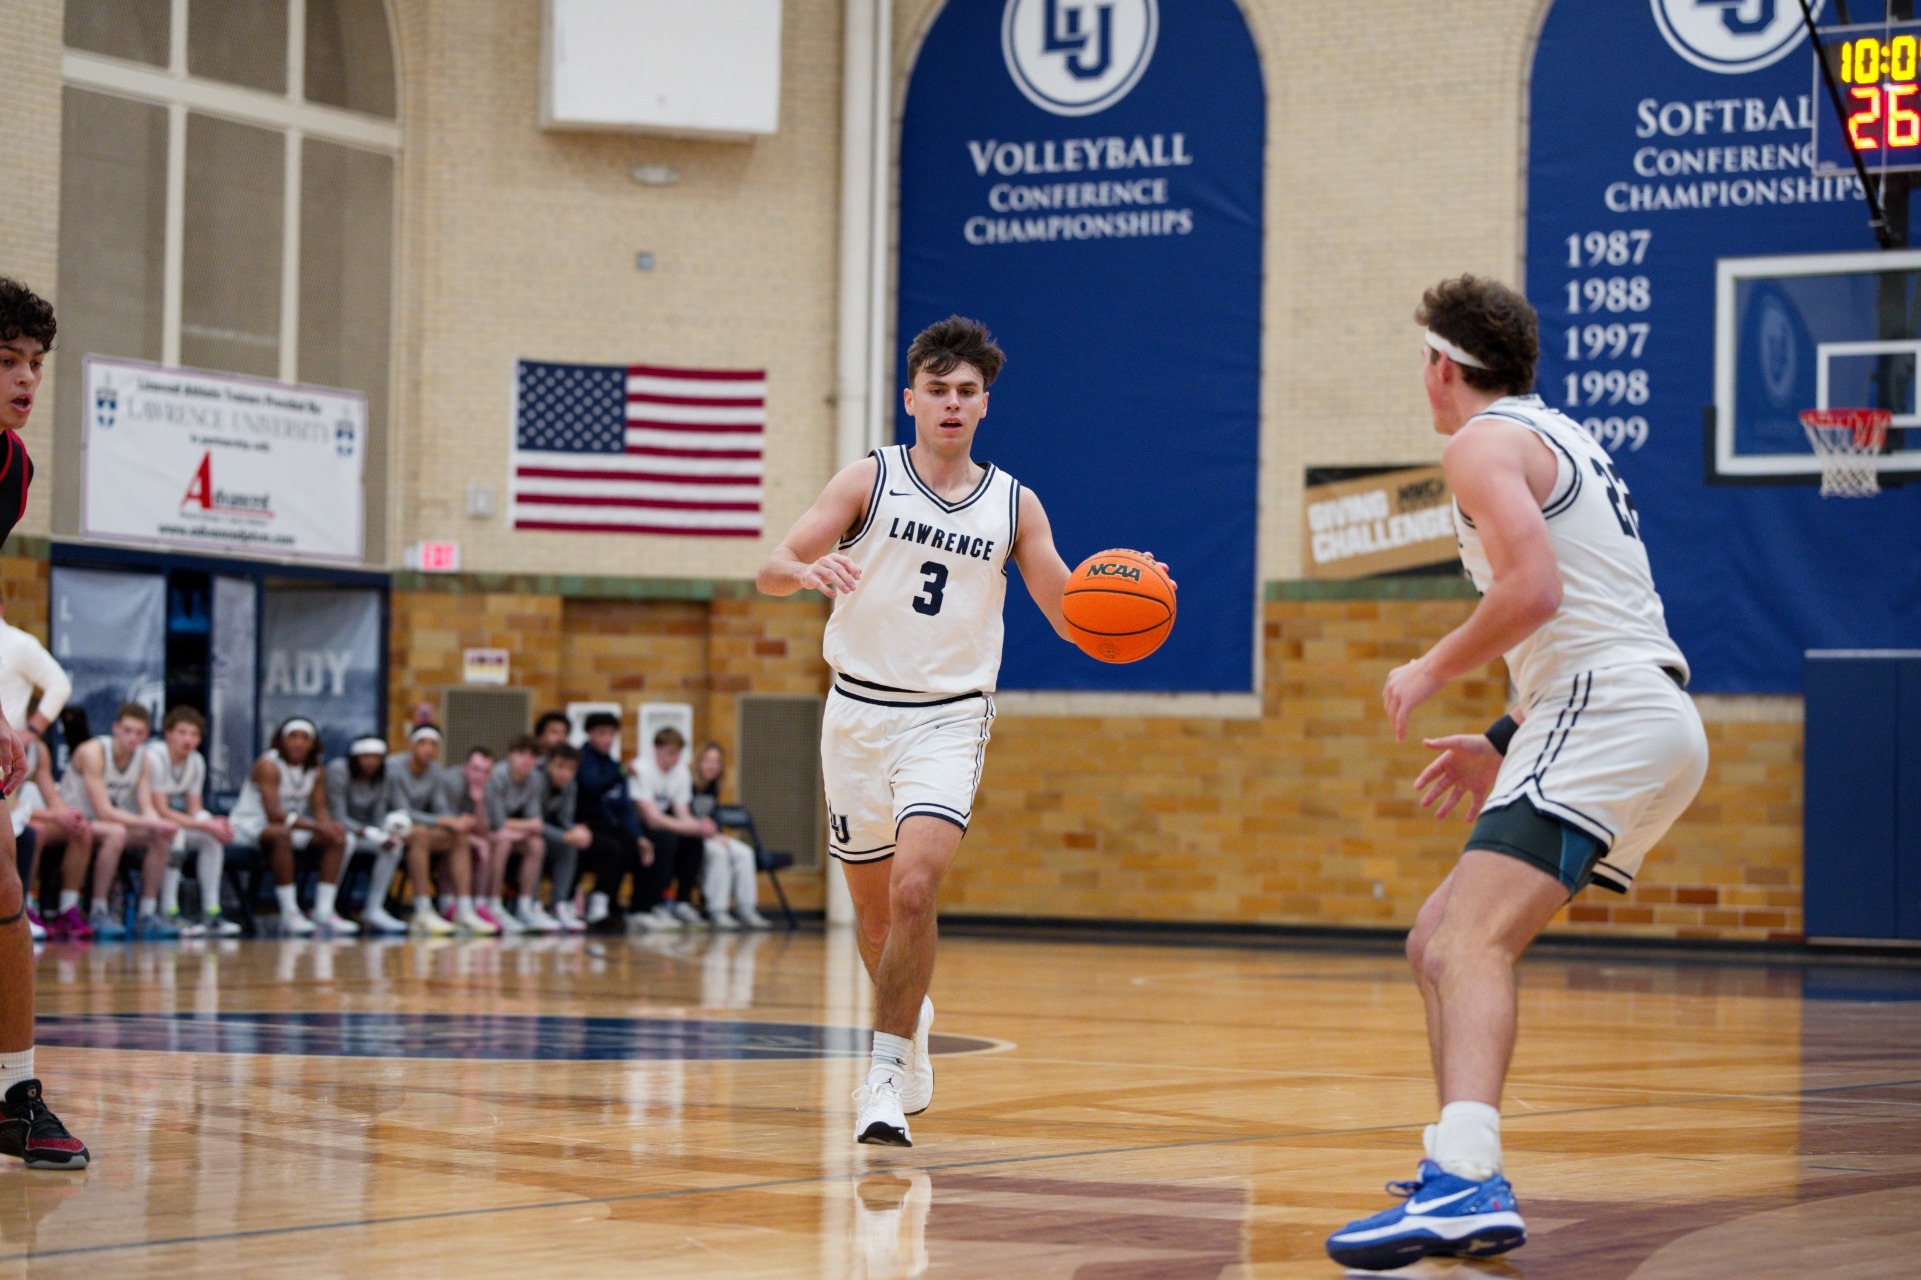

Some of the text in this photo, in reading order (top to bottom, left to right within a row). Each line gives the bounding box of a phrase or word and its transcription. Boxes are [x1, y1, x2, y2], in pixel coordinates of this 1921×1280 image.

[1840, 34, 1921, 84] 10:0
[1636, 95, 1812, 138] SOFTBAL
[1847, 84, 1921, 151] 26
[967, 132, 1193, 176] VOLLEYBALL
[1633, 143, 1812, 177] CONFERENC
[988, 178, 1168, 212] CONFERENCE
[1604, 176, 1867, 212] CHAMPIONSHIPS
[964, 209, 1193, 246] CHAMPIONSHIPS
[1565, 229, 1652, 268] 1987
[1564, 275, 1652, 314] 1988
[1564, 322, 1651, 361] 1997
[1563, 369, 1650, 407] 1998
[1581, 416, 1649, 453] 999
[889, 518, 995, 561] LAWRENCE
[1311, 505, 1456, 564] CHALLENGE
[912, 560, 949, 616] 3
[1086, 563, 1142, 582] NCAA
